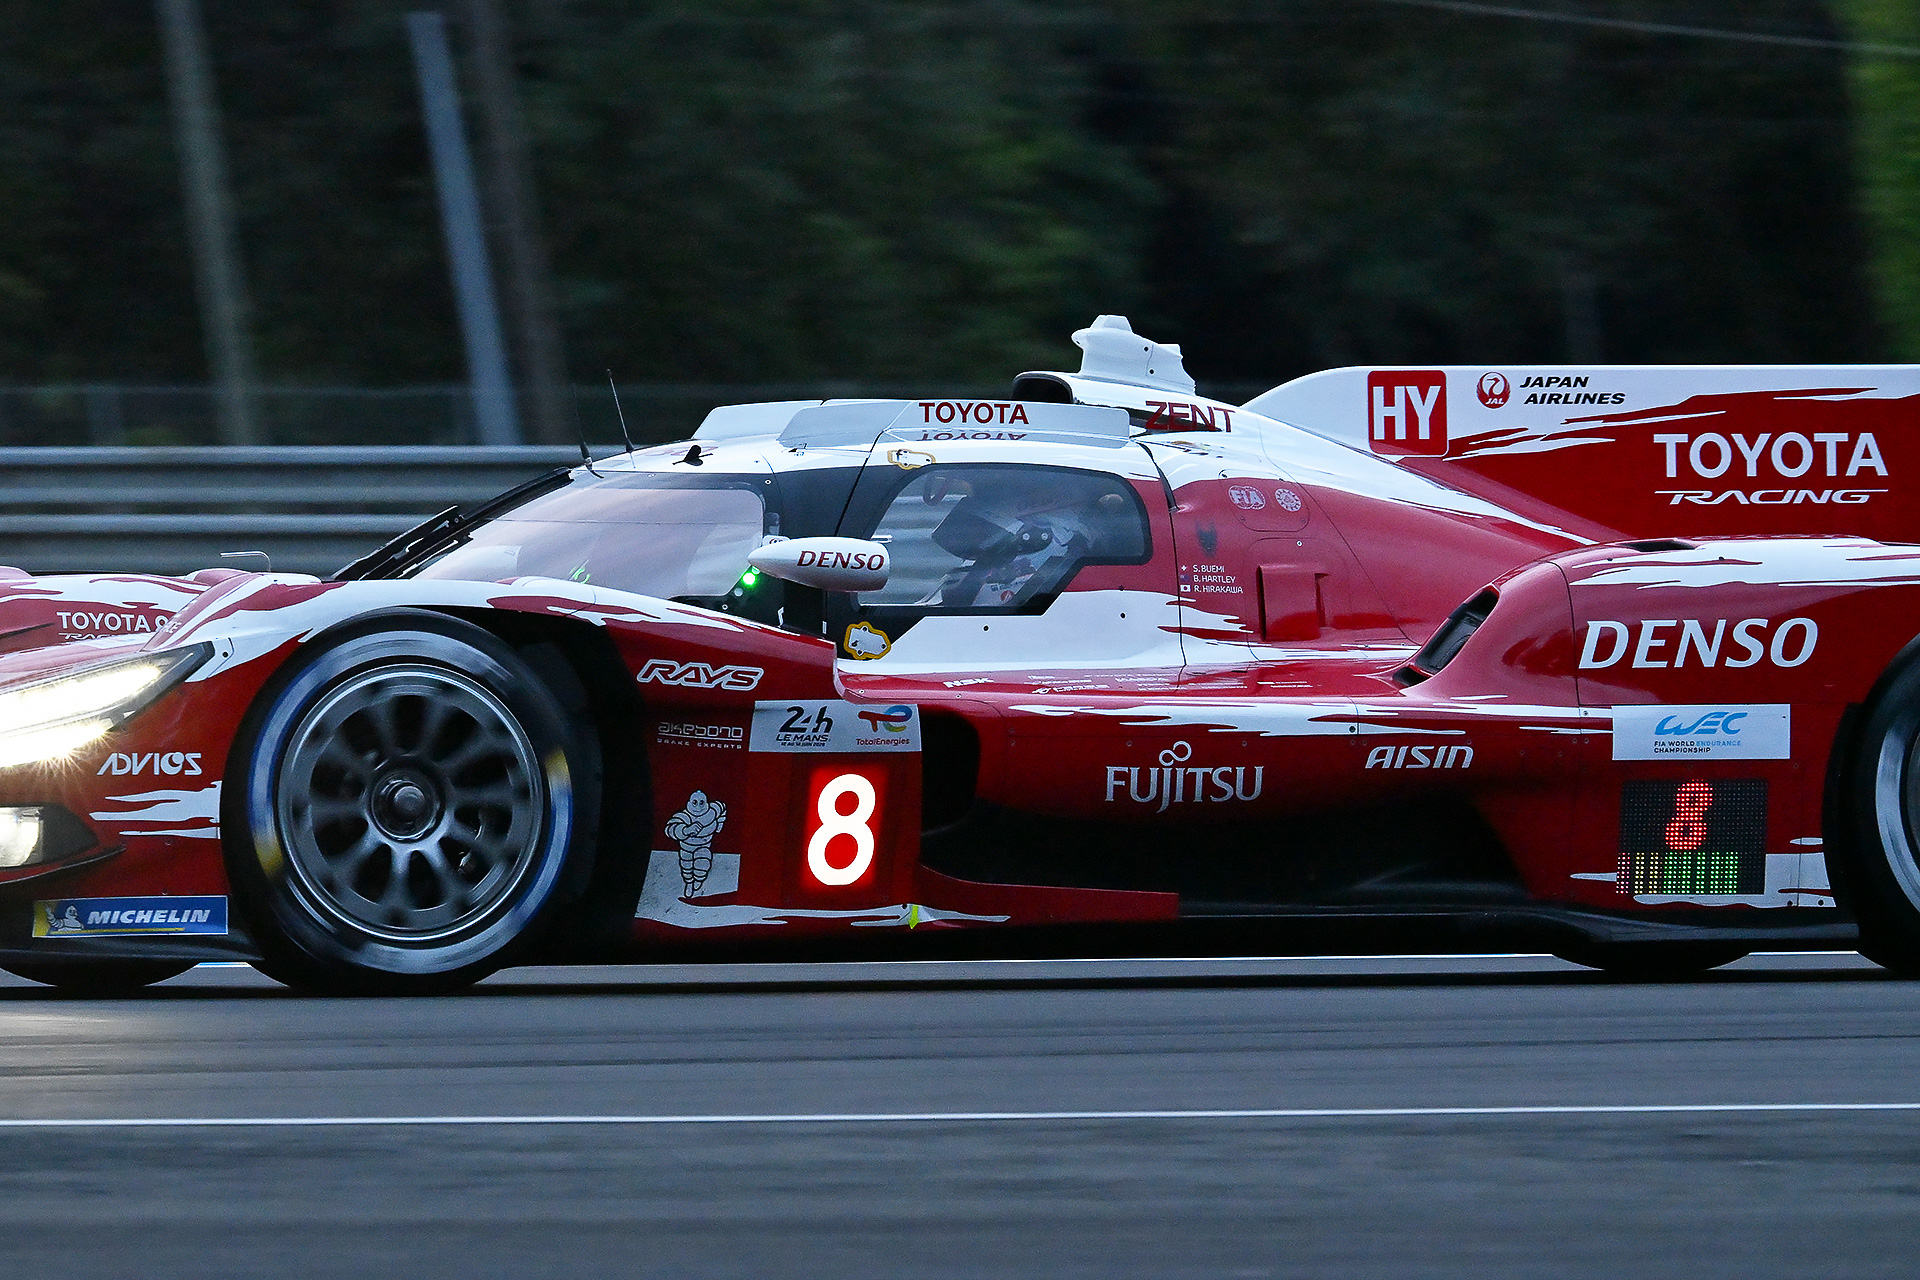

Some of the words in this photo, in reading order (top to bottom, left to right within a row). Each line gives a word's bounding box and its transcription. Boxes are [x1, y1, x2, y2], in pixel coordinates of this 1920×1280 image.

[1519, 376, 1590, 388] JAPAN
[1485, 397, 1505, 405] JAL
[1523, 392, 1626, 405] AIRLINES
[918, 402, 1029, 424] TOYOTA
[1145, 400, 1236, 433] ZENT
[1372, 385, 1442, 440] HY
[1653, 431, 1889, 478] TOYOTA
[1654, 489, 1888, 505] RACING
[797, 550, 885, 571] DENSO
[56, 611, 151, 632] TOYOTA
[1578, 617, 1819, 669] DENSO
[637, 658, 764, 691] RAYS
[1654, 711, 1748, 736] WEC
[656, 738, 690, 746] BRAKE
[696, 742, 742, 750] EXPERTS
[776, 733, 792, 742] LE
[793, 734, 829, 742] MANS
[856, 737, 910, 746] TotalEnergies
[97, 752, 202, 776] ADVICS
[1365, 745, 1474, 769] AISIN
[1105, 766, 1264, 814] FUJITSU
[1665, 778, 1713, 850] 8
[807, 773, 876, 886] 8
[87, 909, 211, 925] MICHELIN
